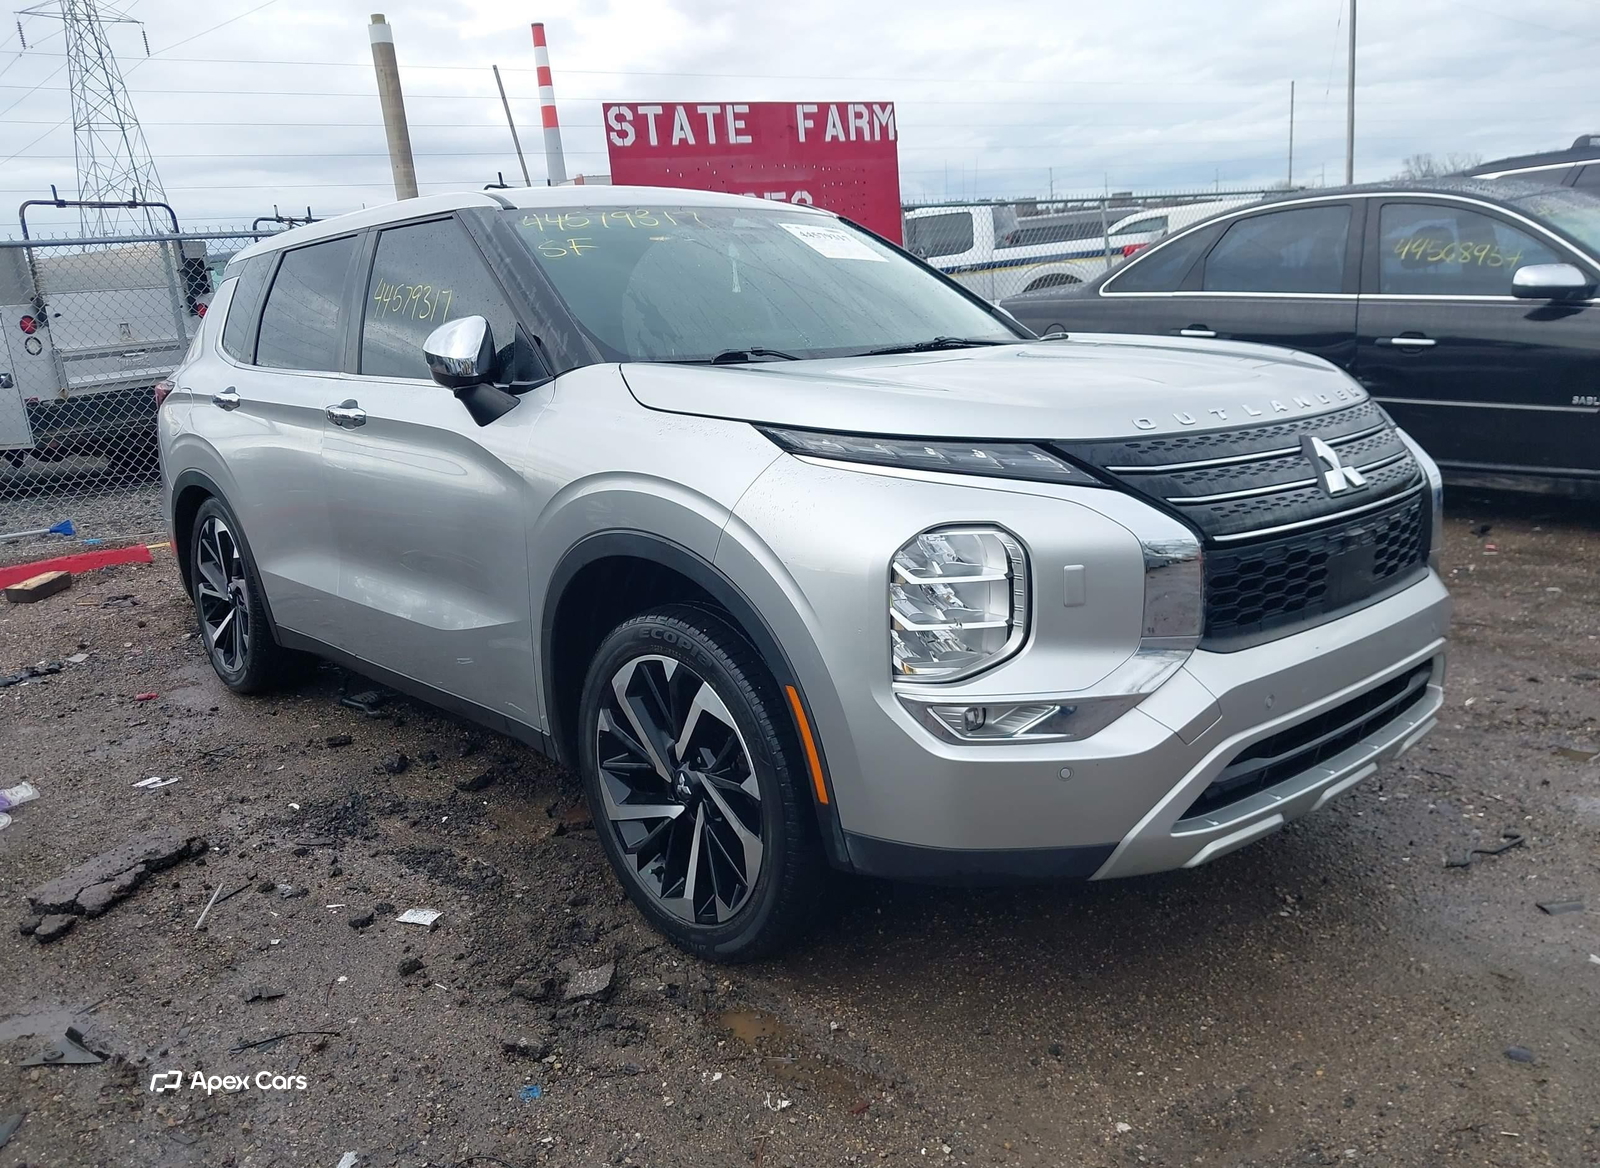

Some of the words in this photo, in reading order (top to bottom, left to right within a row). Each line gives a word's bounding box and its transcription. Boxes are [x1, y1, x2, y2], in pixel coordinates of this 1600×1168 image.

[606, 104, 753, 147] STATE
[796, 103, 896, 142] FARM
[538, 237, 600, 258] SF
[374, 278, 452, 323] 44579317
[1132, 387, 1361, 430] OUTLANDER
[1572, 395, 1600, 406] SABL
